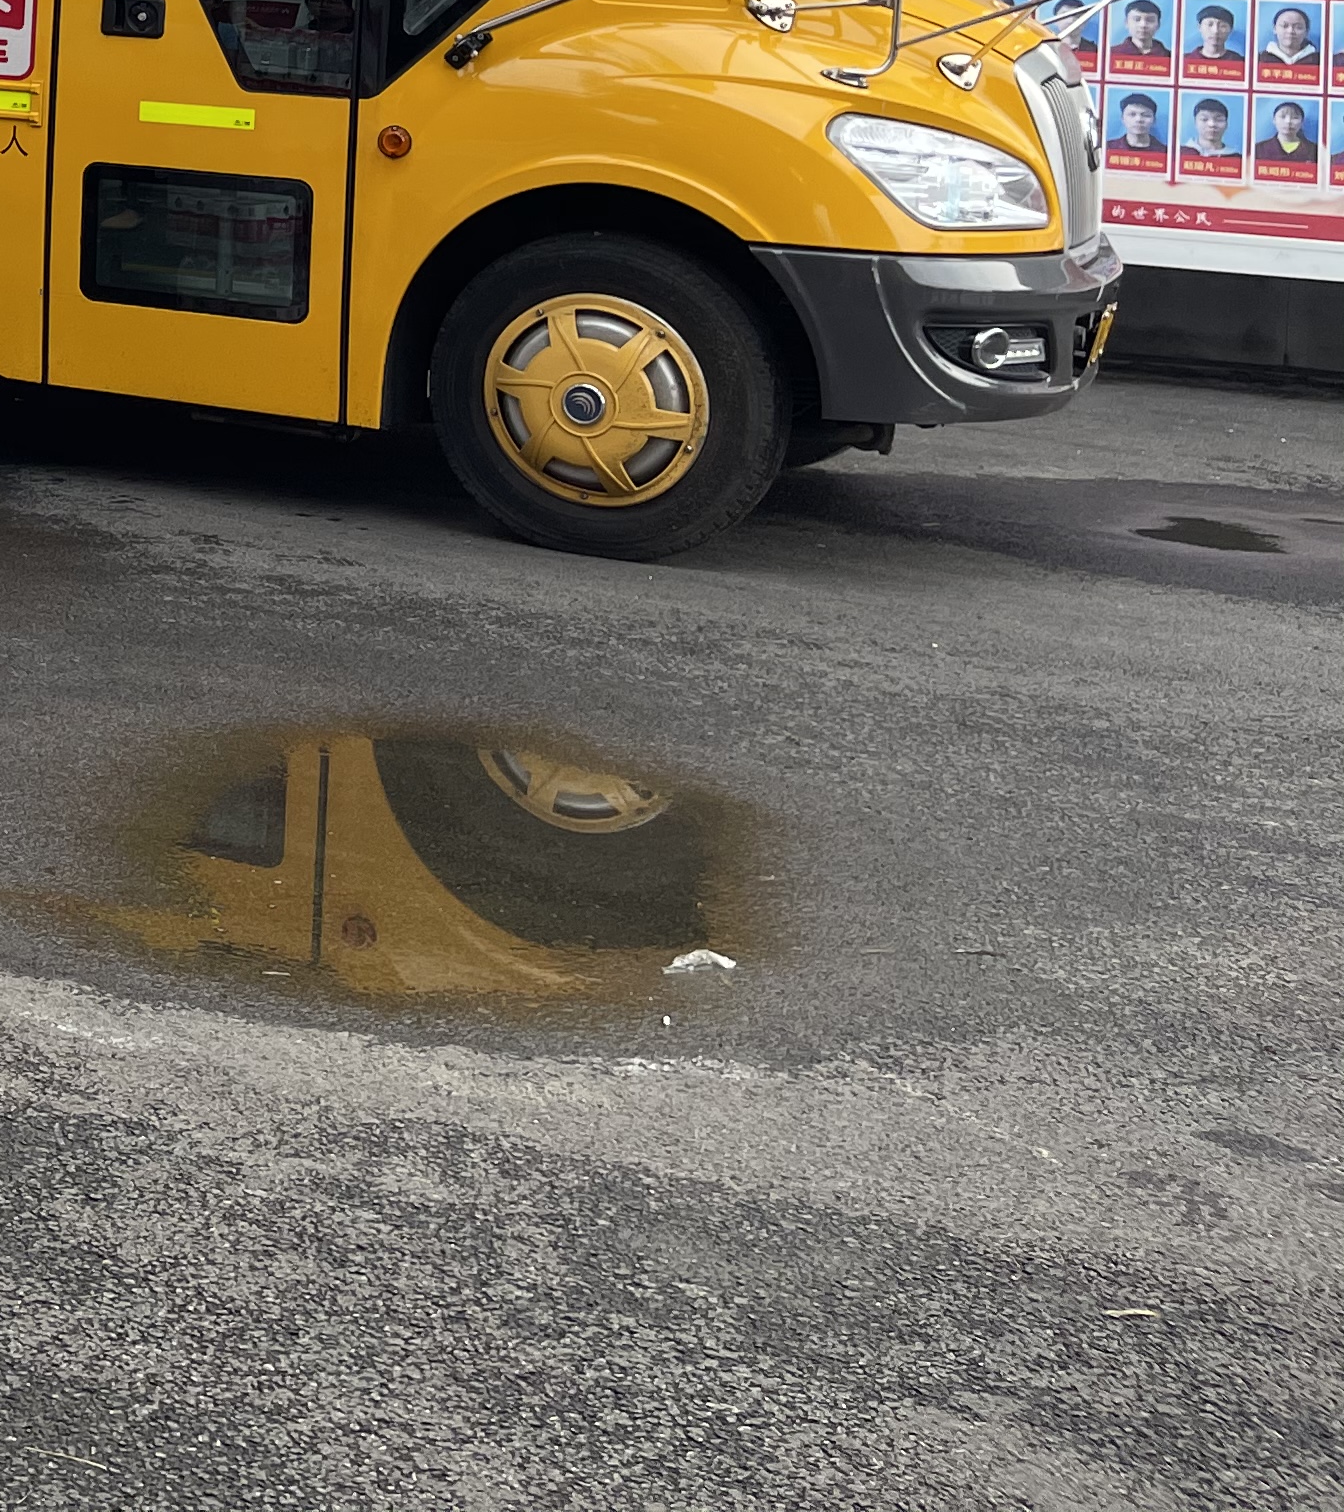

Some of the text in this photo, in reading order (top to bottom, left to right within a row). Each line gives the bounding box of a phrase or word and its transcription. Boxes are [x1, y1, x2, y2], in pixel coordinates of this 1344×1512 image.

[0, 125, 30, 158] 人
[1111, 204, 1213, 227] 的世界公民
